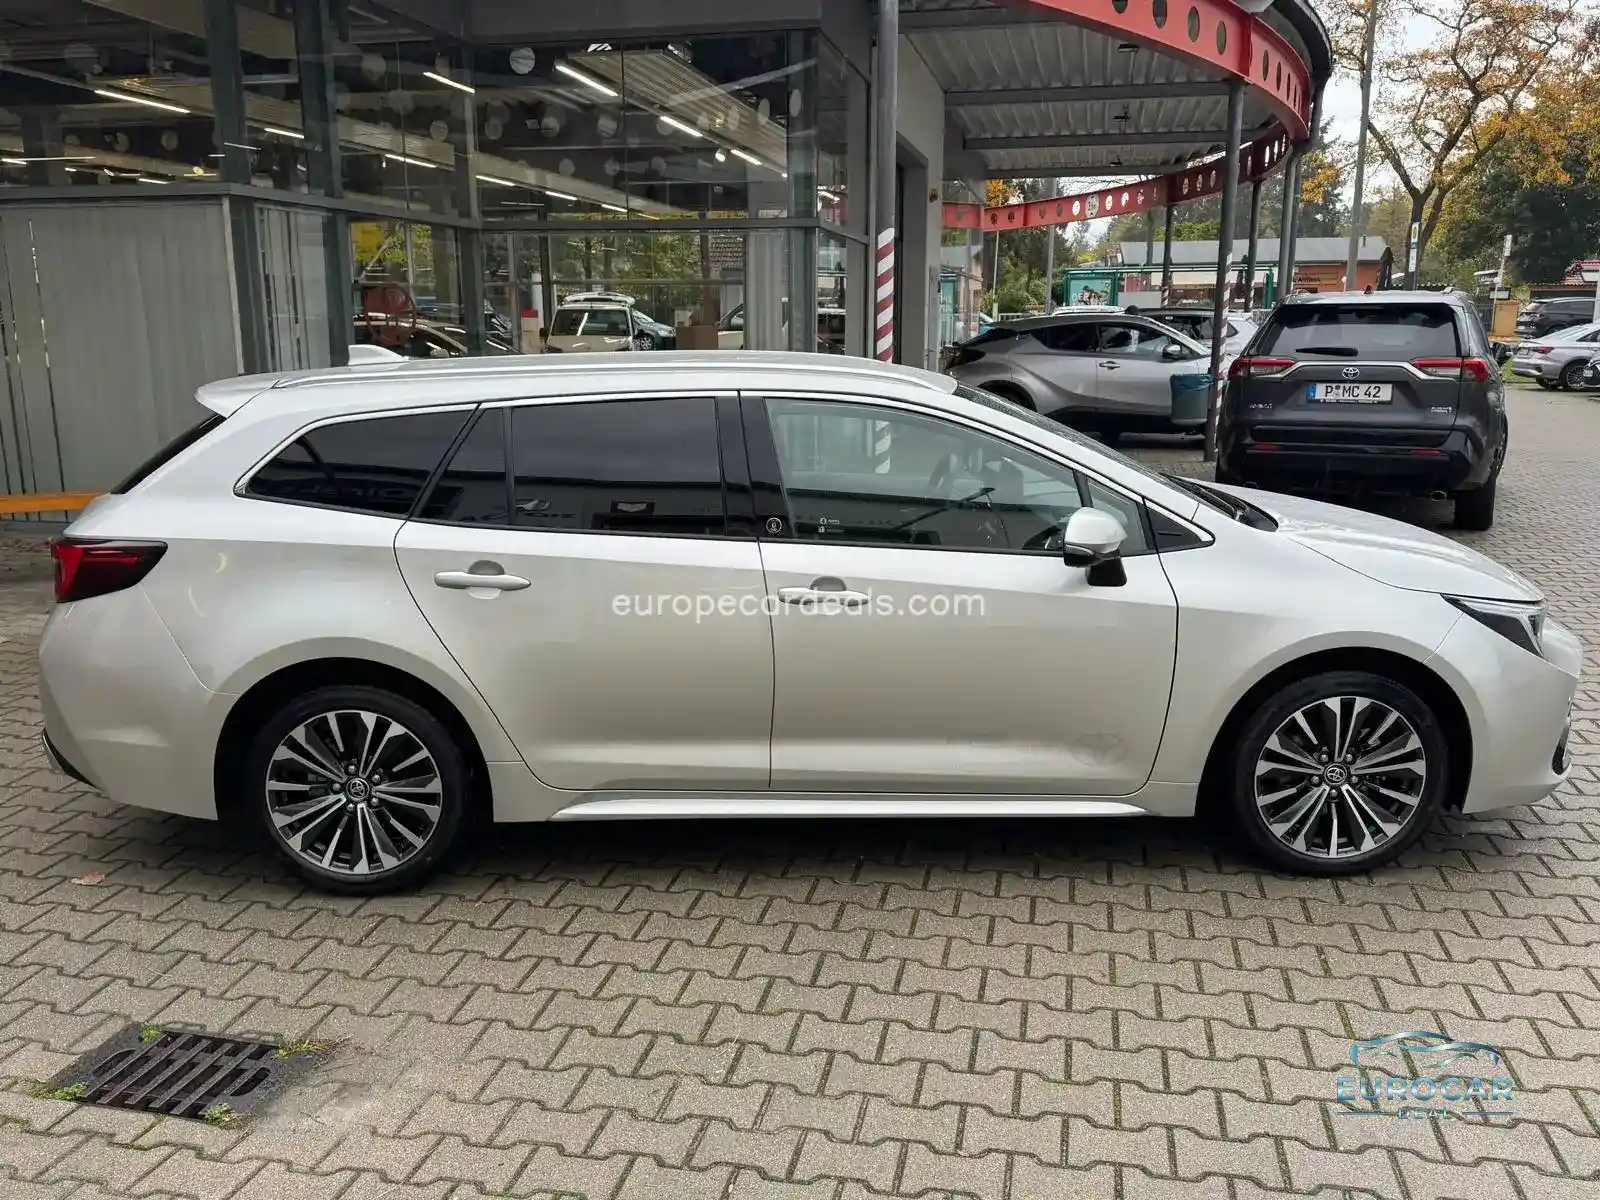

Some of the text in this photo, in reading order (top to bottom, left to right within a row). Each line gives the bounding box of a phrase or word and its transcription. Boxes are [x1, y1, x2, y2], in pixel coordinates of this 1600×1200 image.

[1324, 385, 1381, 399] P MC 42
